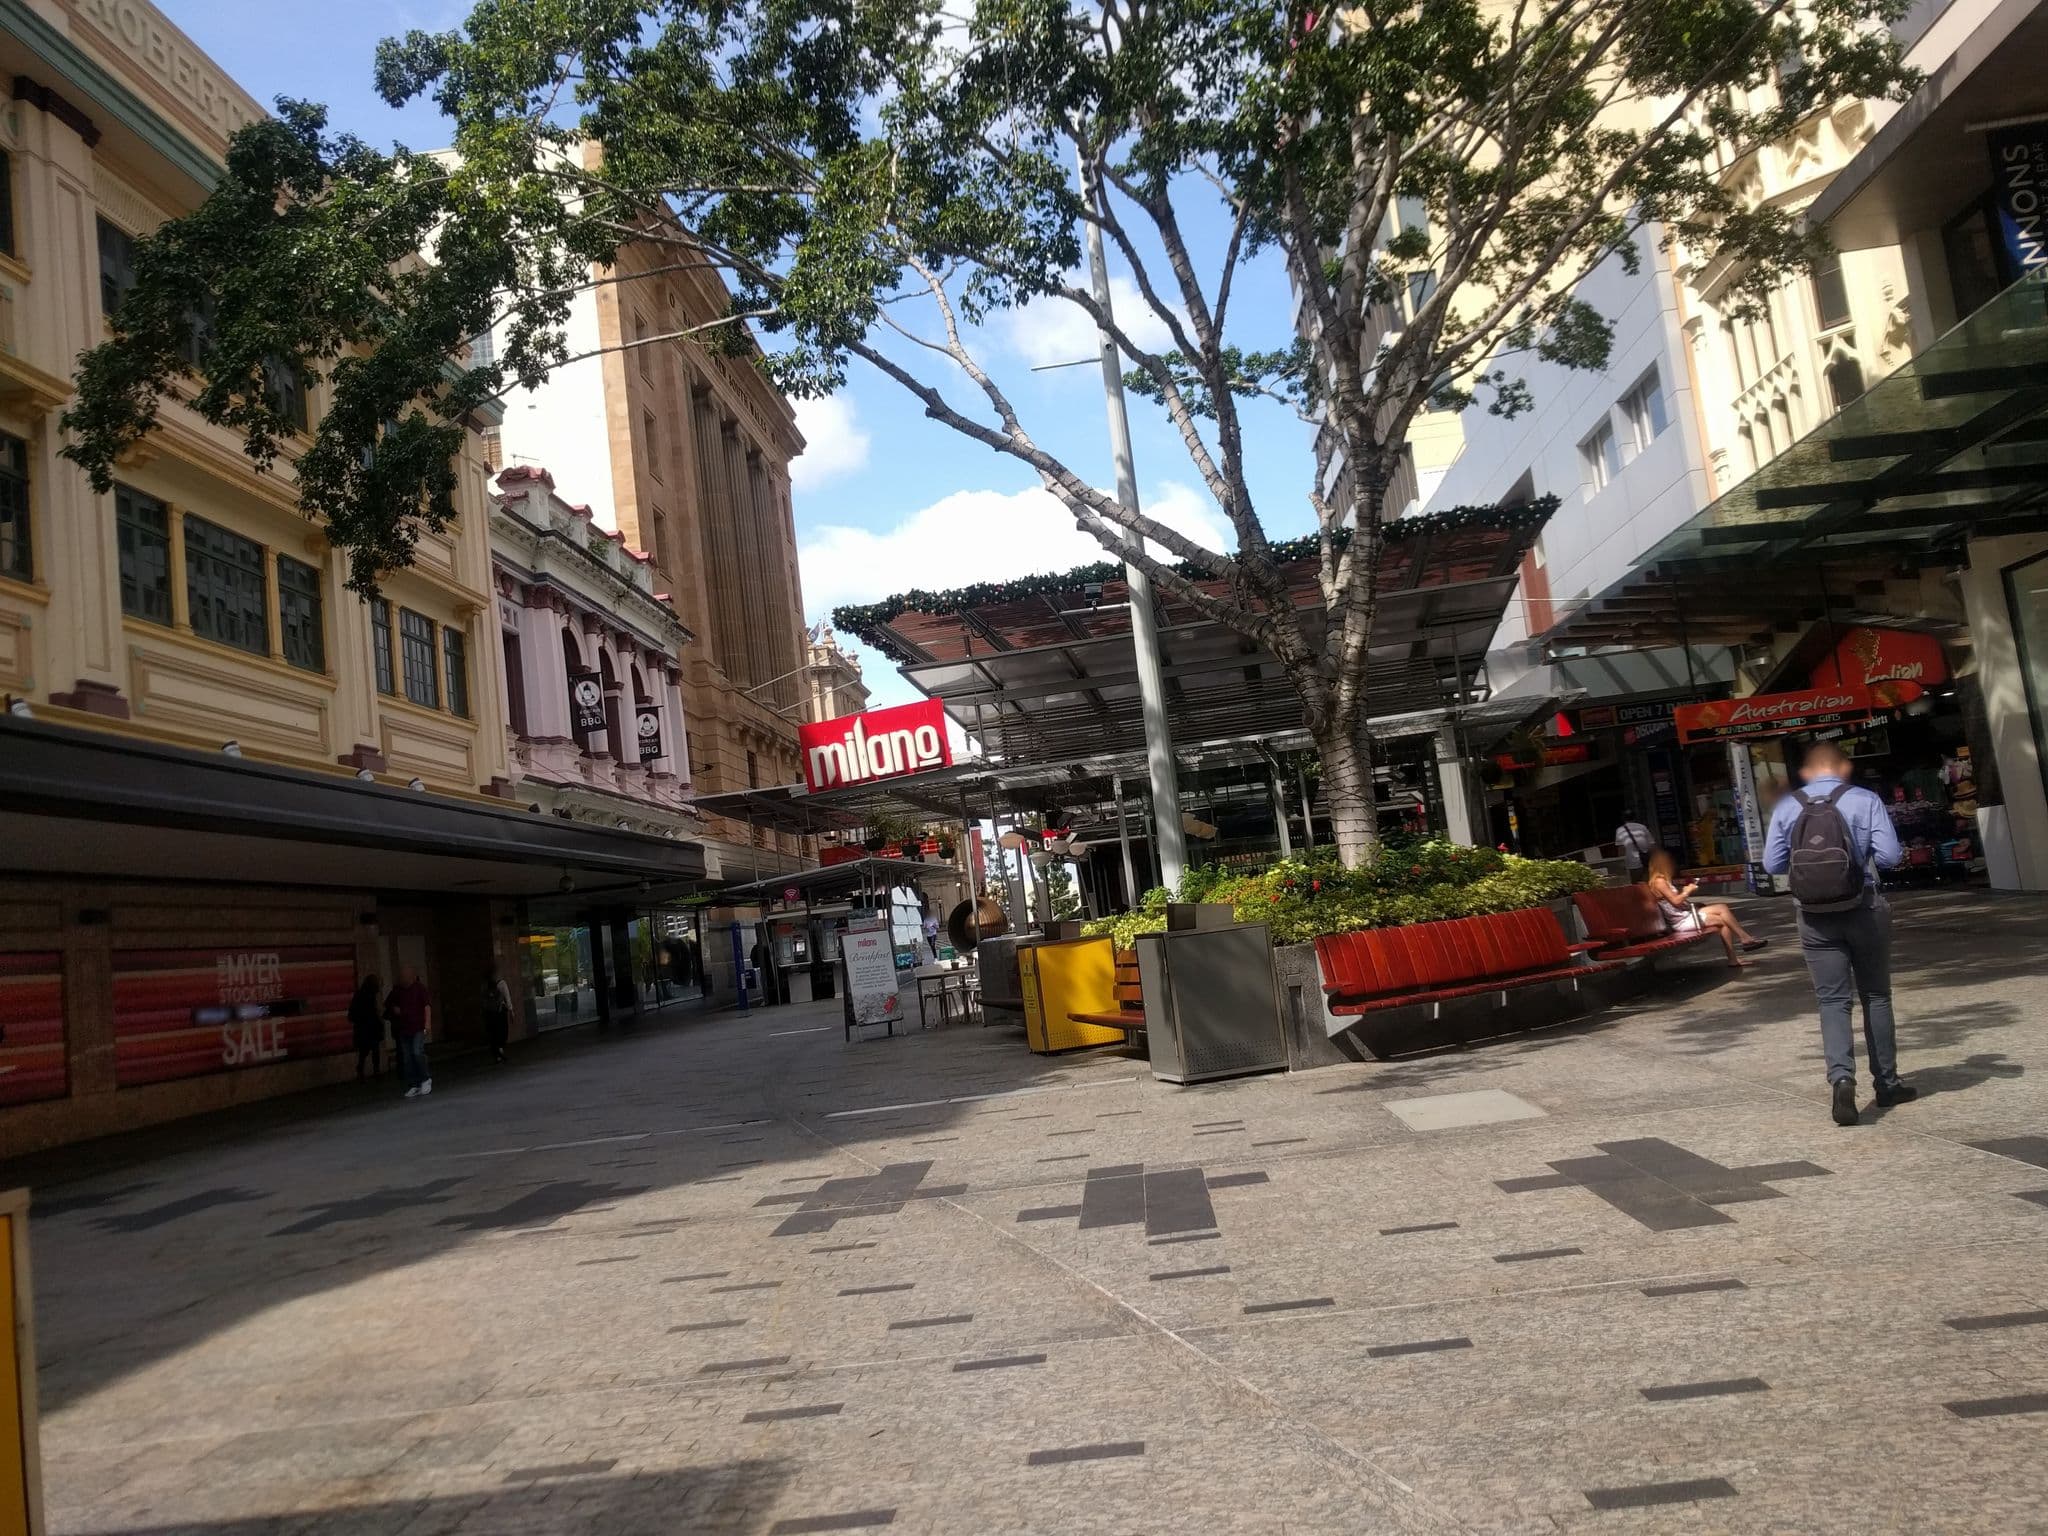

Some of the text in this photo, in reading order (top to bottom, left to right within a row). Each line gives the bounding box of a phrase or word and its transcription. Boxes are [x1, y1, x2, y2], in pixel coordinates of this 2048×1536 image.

[1619, 705, 1654, 721] OPEN
[1656, 703, 1664, 716] 7
[1728, 695, 1854, 722] Australian
[1818, 714, 1841, 724] GIFTS
[581, 716, 602, 726] BBQ
[639, 745, 659, 754] BBQ
[808, 716, 943, 788] milano
[224, 952, 281, 985] MYER
[222, 1016, 288, 1065] SALE
